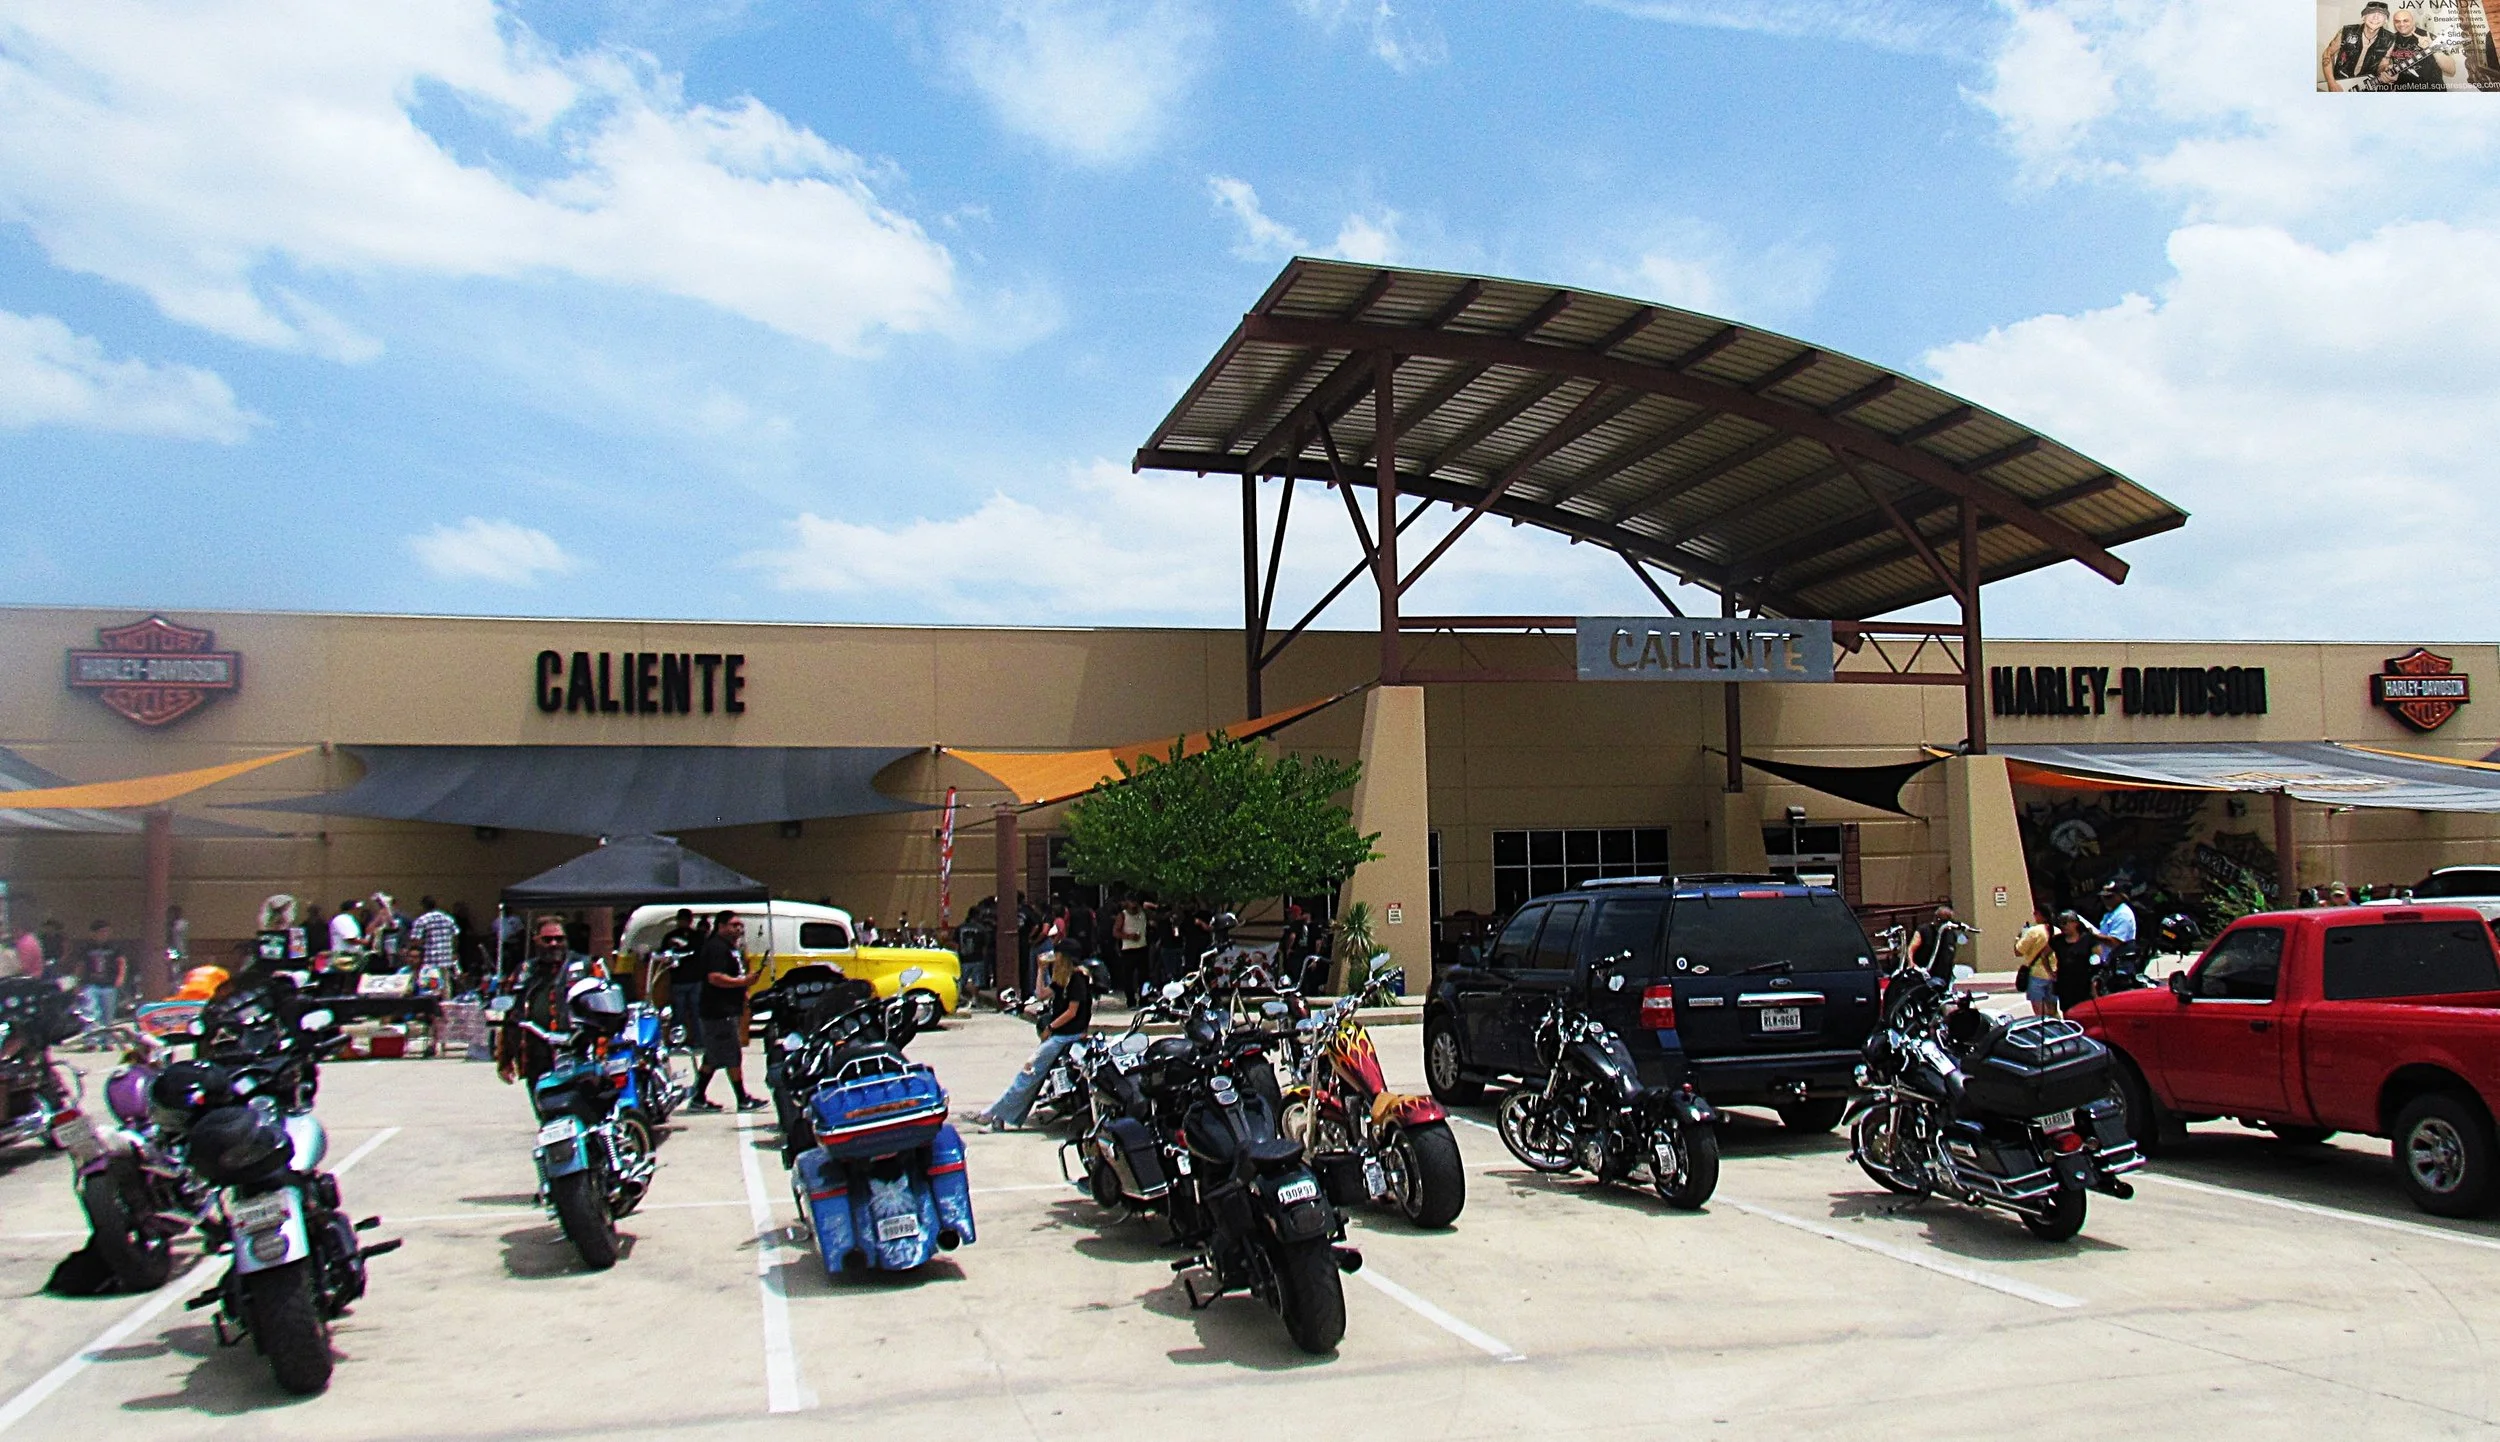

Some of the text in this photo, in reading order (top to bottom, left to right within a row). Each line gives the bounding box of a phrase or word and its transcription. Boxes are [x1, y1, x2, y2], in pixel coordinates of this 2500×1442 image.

[1608, 628, 1808, 672] CALIENTE
[536, 650, 746, 714] CALIENTE
[1990, 665, 2268, 715] HARLEY-DAVIDSON
[2384, 680, 2465, 696] HARLEY-DAVIDSON
